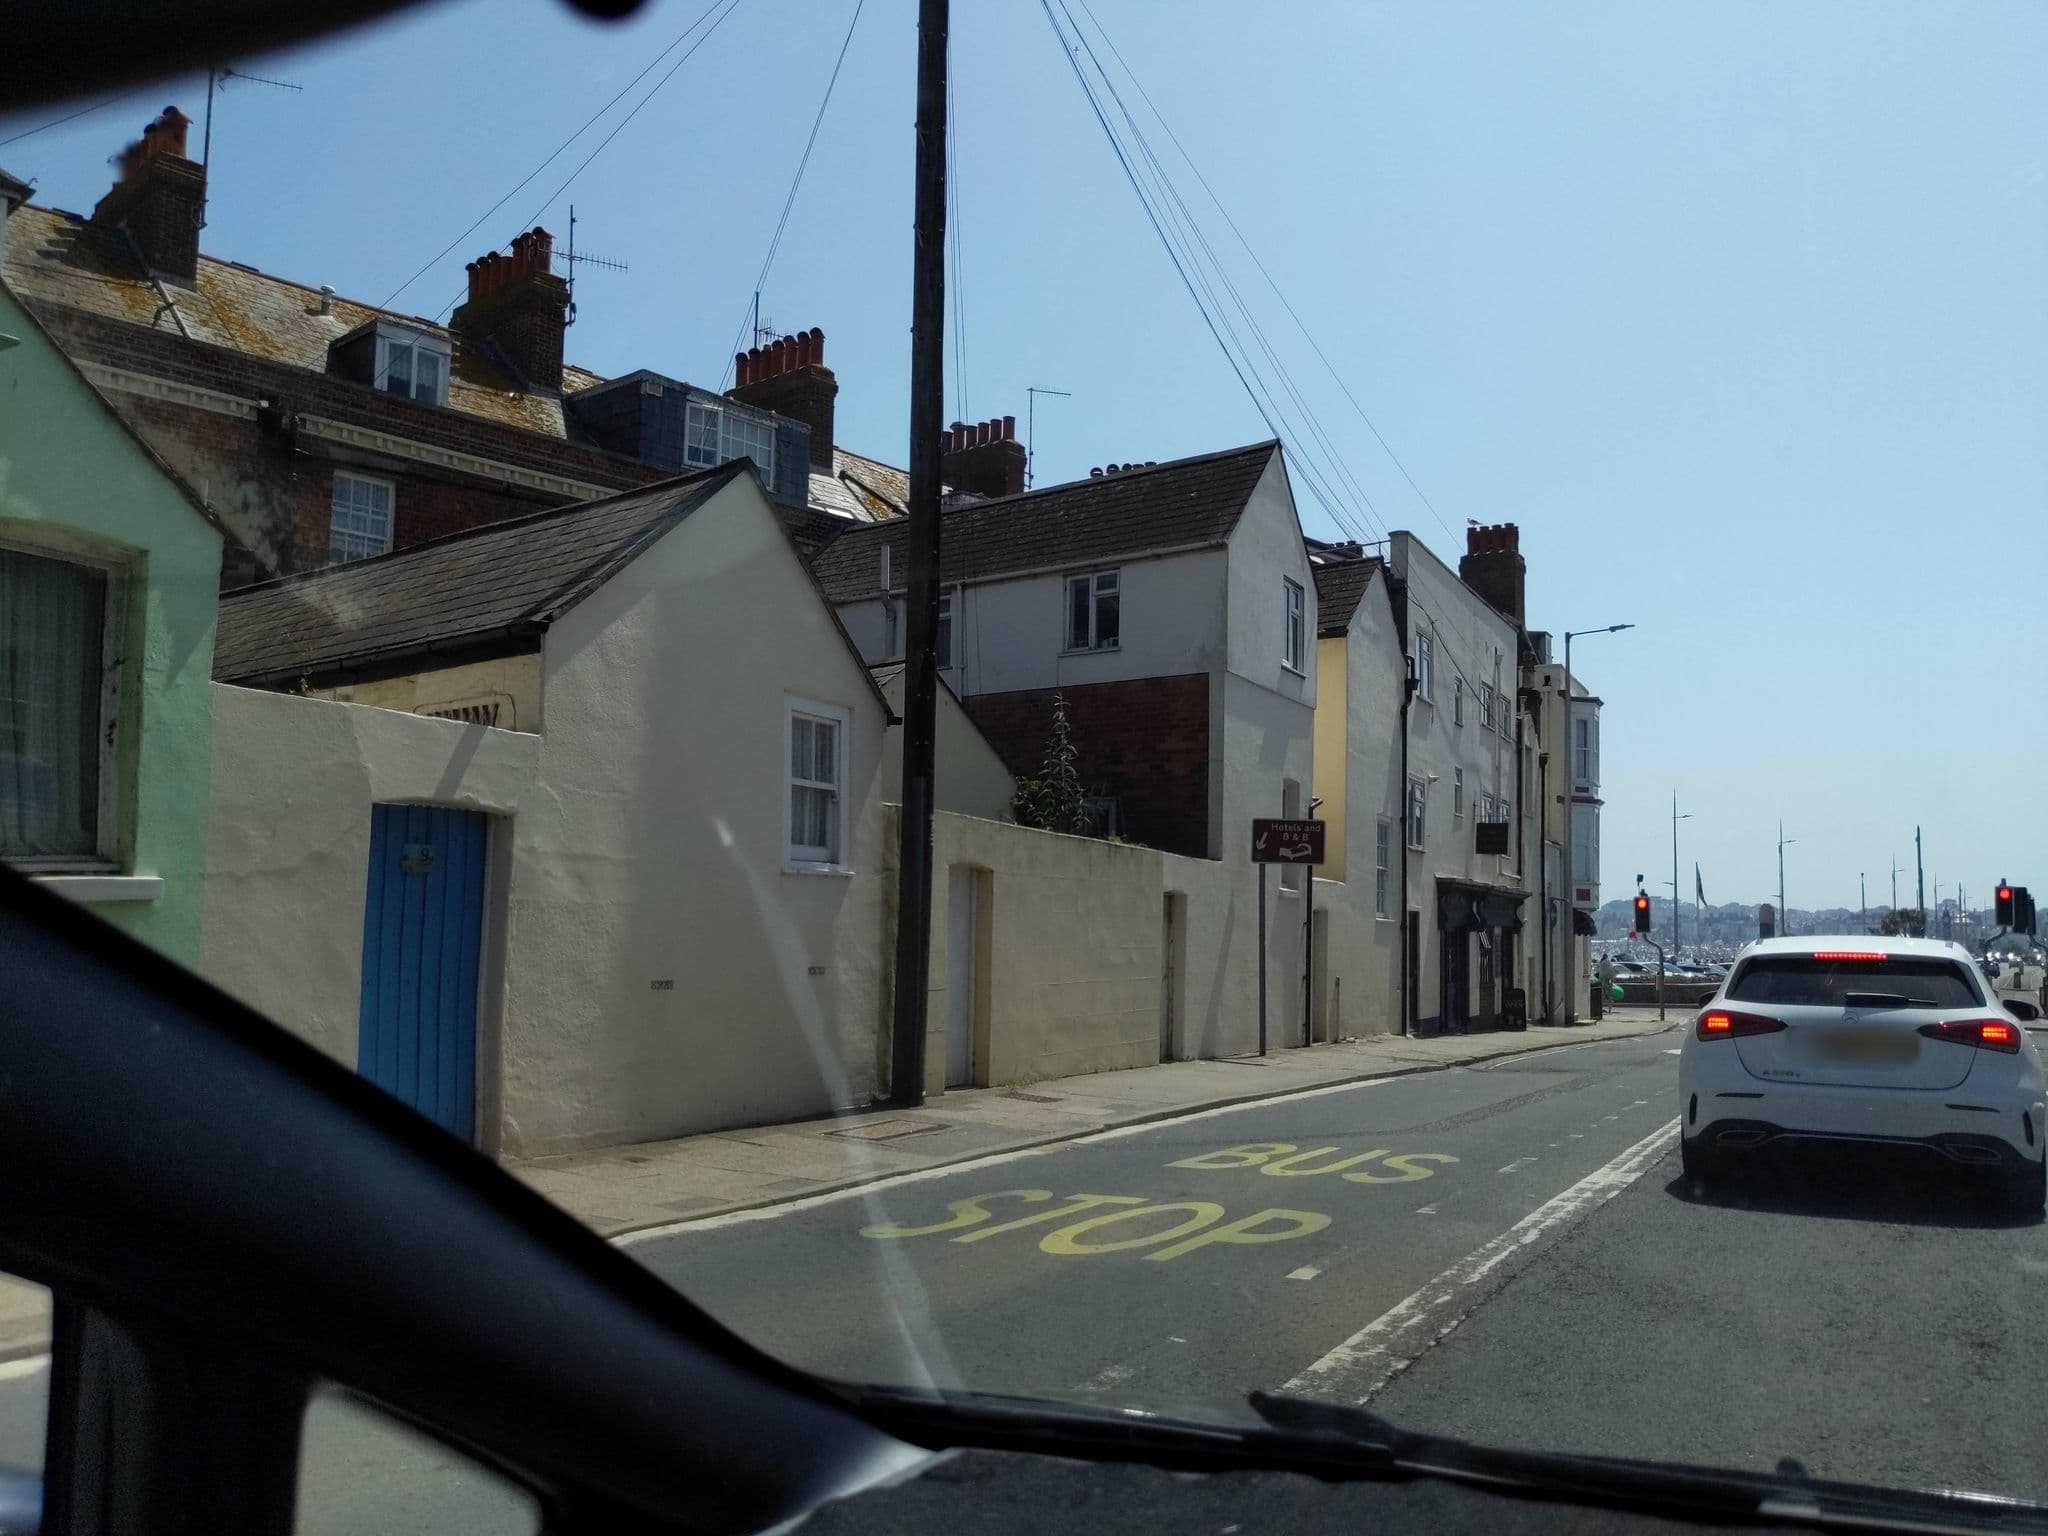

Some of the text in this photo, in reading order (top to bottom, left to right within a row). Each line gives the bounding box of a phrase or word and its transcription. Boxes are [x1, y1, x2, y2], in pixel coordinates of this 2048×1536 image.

[1271, 823, 1321, 832] Hotels and
[1282, 832, 1309, 841] B & B
[1164, 1143, 1461, 1184] BUS
[859, 1189, 1333, 1262] STOP
